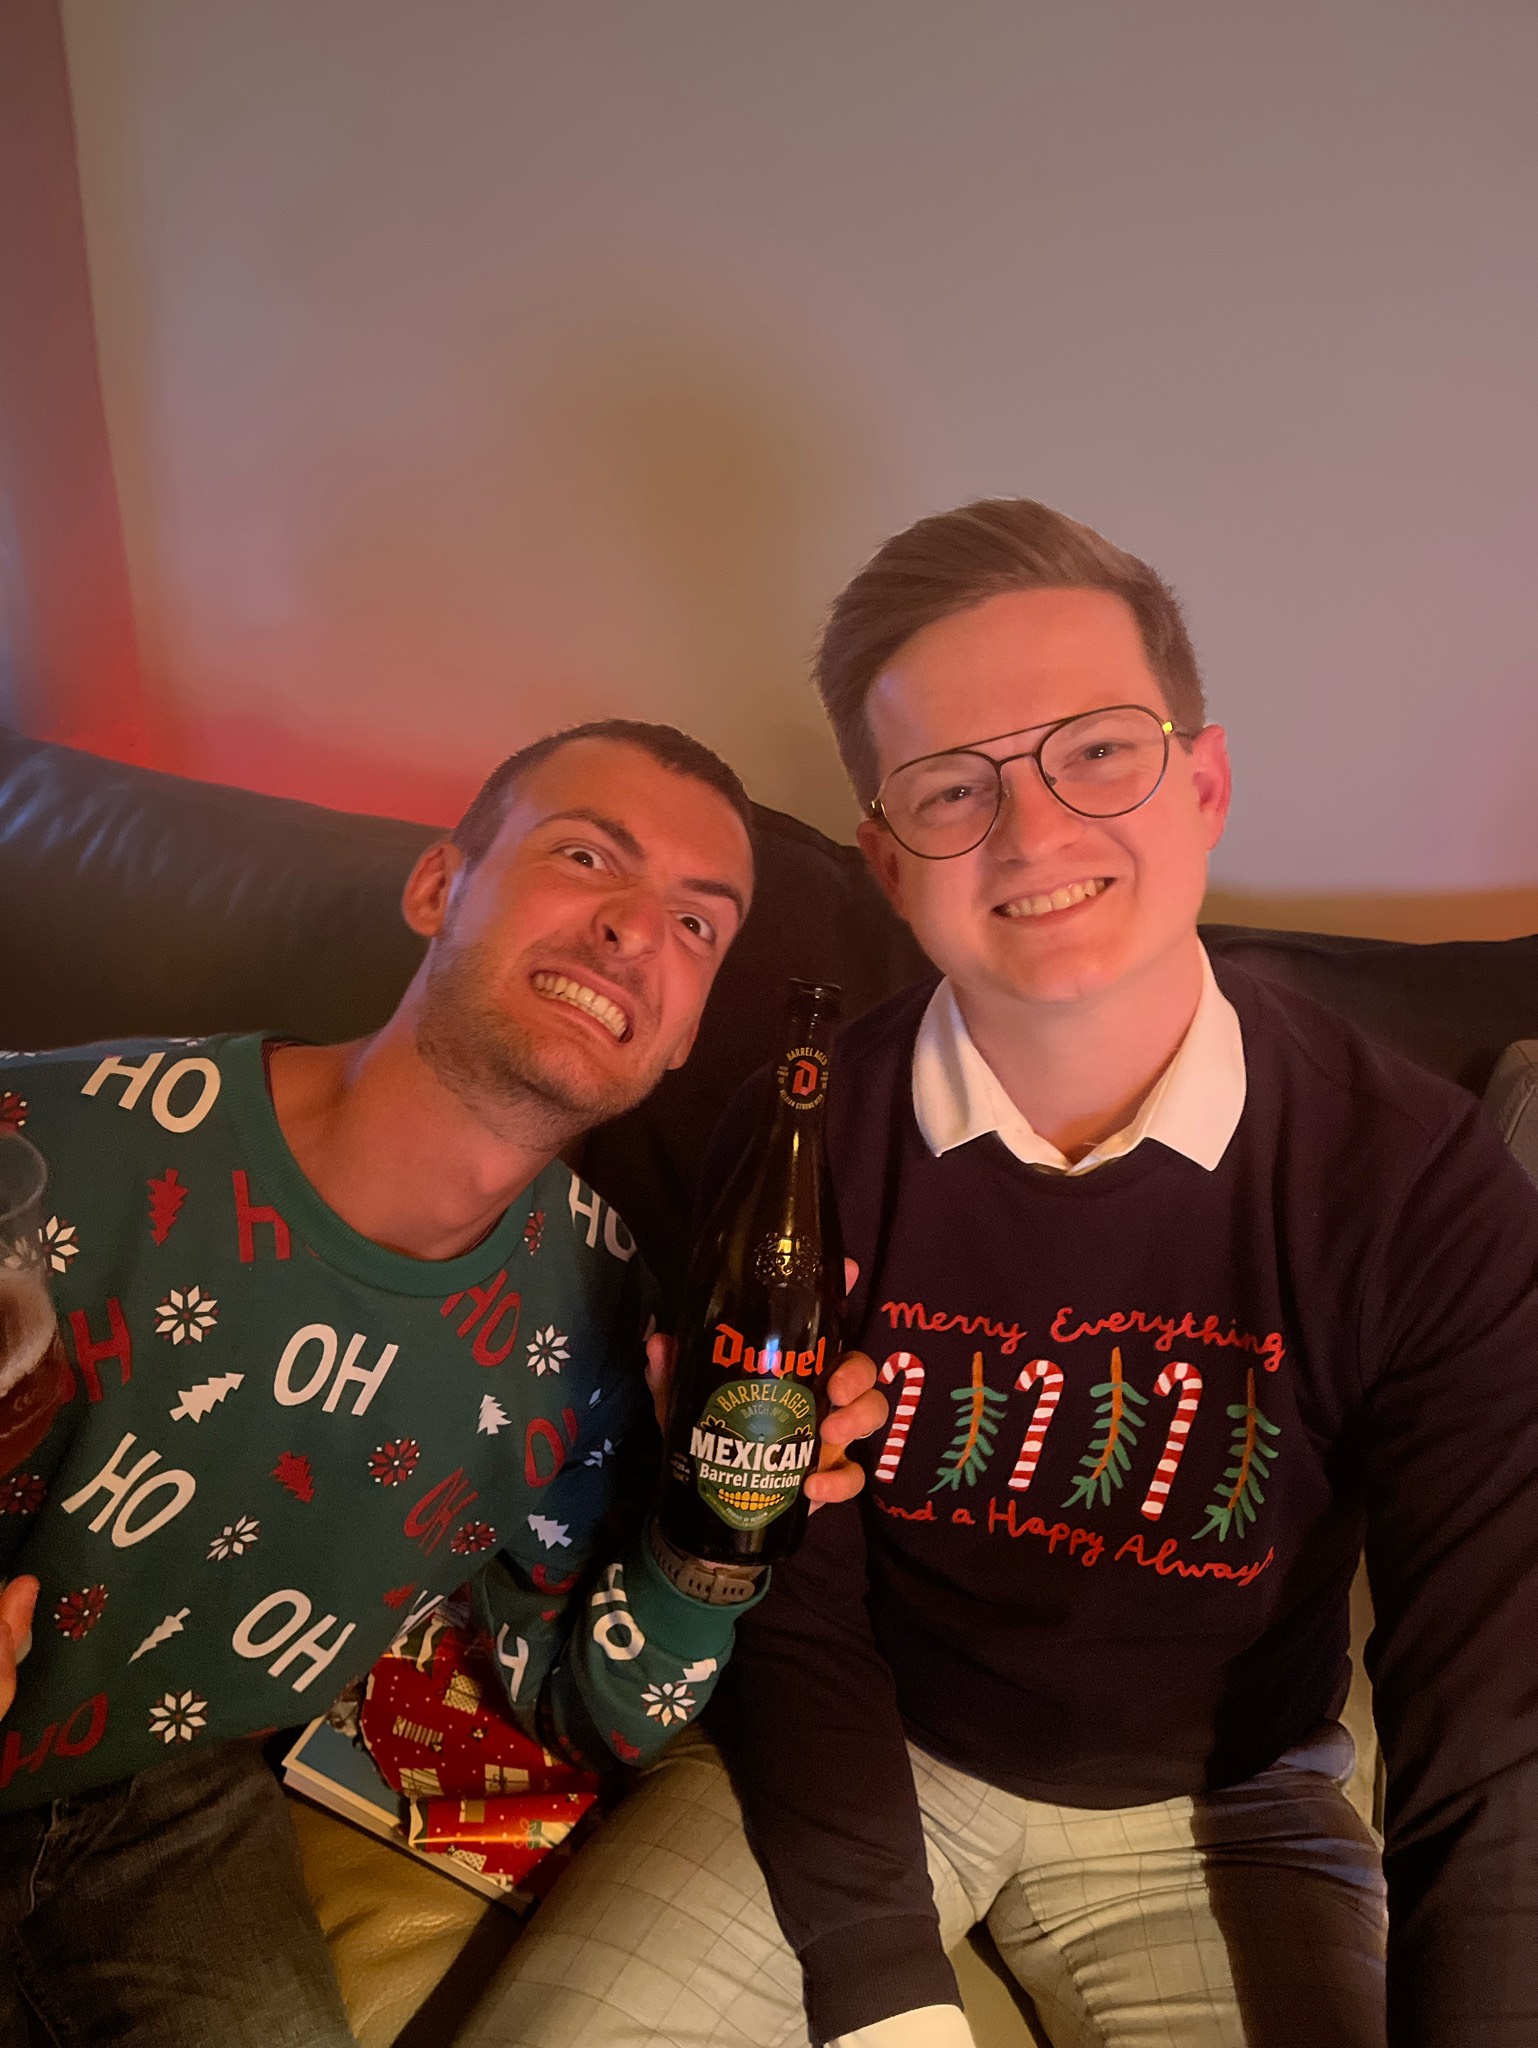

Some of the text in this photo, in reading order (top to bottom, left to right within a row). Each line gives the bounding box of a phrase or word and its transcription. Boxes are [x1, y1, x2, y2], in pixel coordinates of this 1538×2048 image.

[81, 1052, 221, 1133] HO
[274, 1324, 399, 1416] OH
[712, 1323, 826, 1377] Duvel
[880, 1302, 1285, 1371] Merry Everything
[717, 1384, 810, 1419] BARREL AGED
[689, 1427, 815, 1472] MEXICAN
[699, 1463, 748, 1488] Barrel
[750, 1472, 800, 1489] Edición
[61, 1432, 197, 1548] HO
[952, 1508, 975, 1525] a
[988, 1497, 1104, 1567] Happy
[232, 1589, 356, 1692] OH
